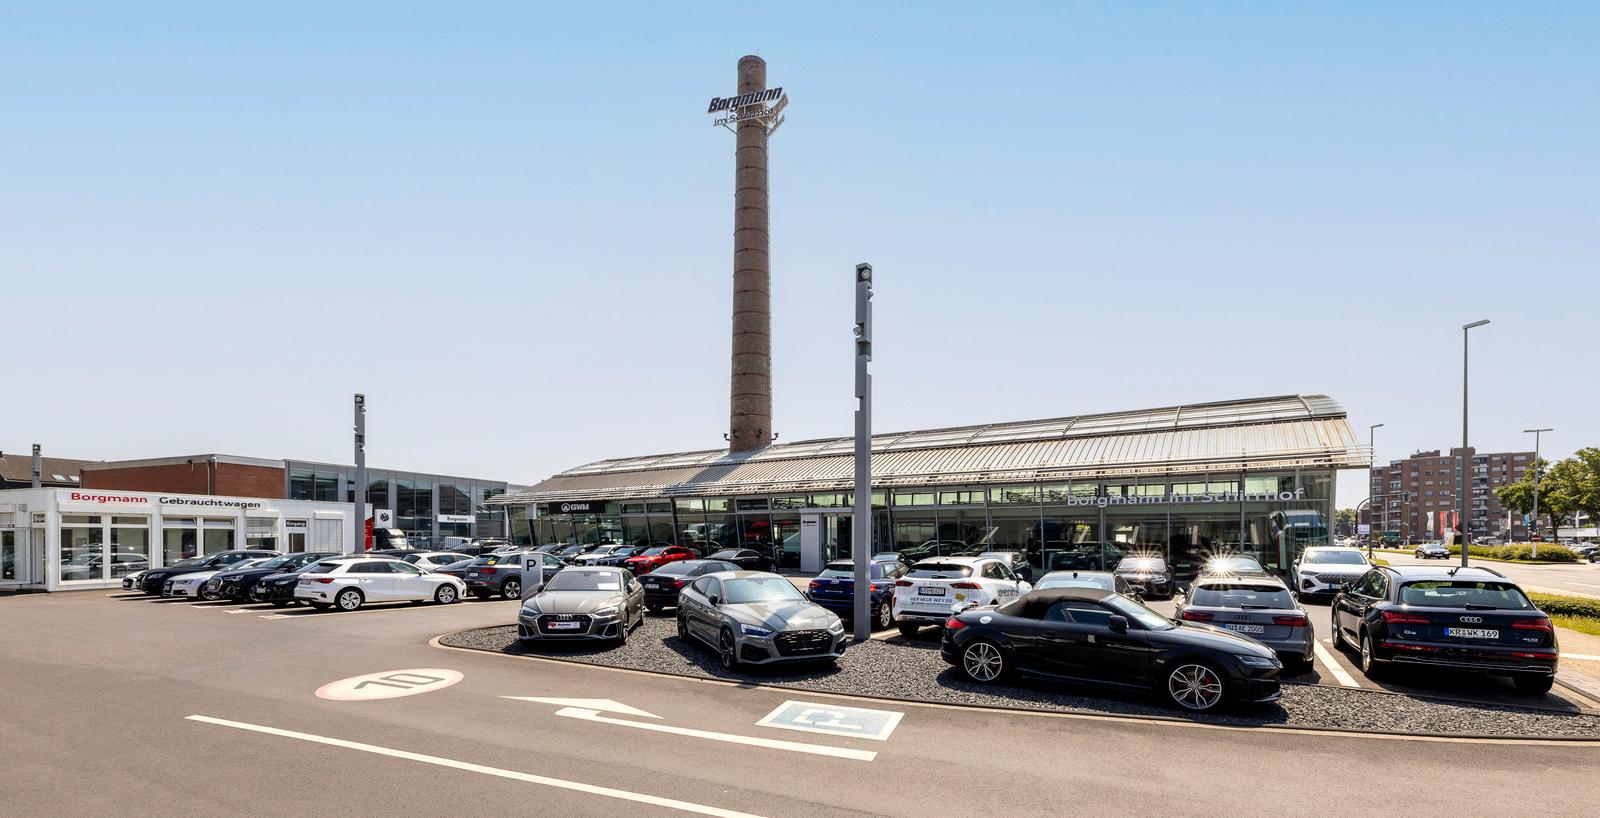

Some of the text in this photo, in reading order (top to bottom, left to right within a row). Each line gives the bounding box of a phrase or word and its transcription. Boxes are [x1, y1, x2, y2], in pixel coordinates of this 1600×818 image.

[708, 87, 783, 113] Borgmann
[71, 492, 261, 509] Borgmann Gebrauchtwagen
[1067, 488, 1304, 507] Borgmann im Schirrhof
[570, 503, 590, 511] GWM
[526, 559, 537, 571] P
[1449, 628, 1498, 638] KR WK 169
[353, 673, 446, 690] 10
